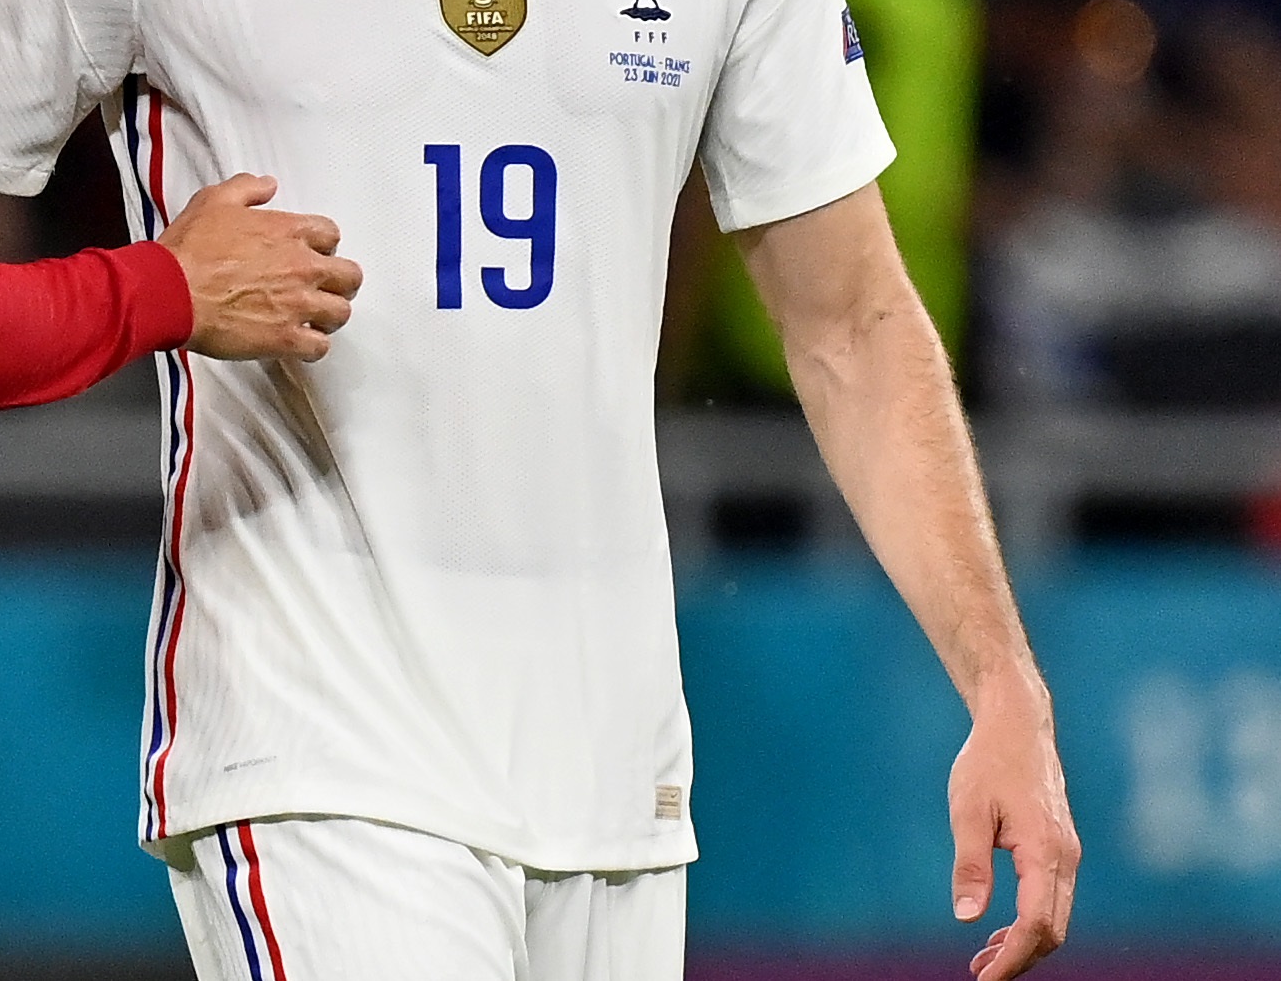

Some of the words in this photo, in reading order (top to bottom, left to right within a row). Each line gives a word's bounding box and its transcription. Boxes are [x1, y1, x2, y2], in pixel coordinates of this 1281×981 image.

[466, 11, 504, 25] FIFA
[609, 52, 656, 68] PORTUGAL
[665, 57, 690, 73] FRANCE
[624, 68, 638, 82] 23
[661, 72, 680, 87] 2021
[423, 144, 557, 309] 19
